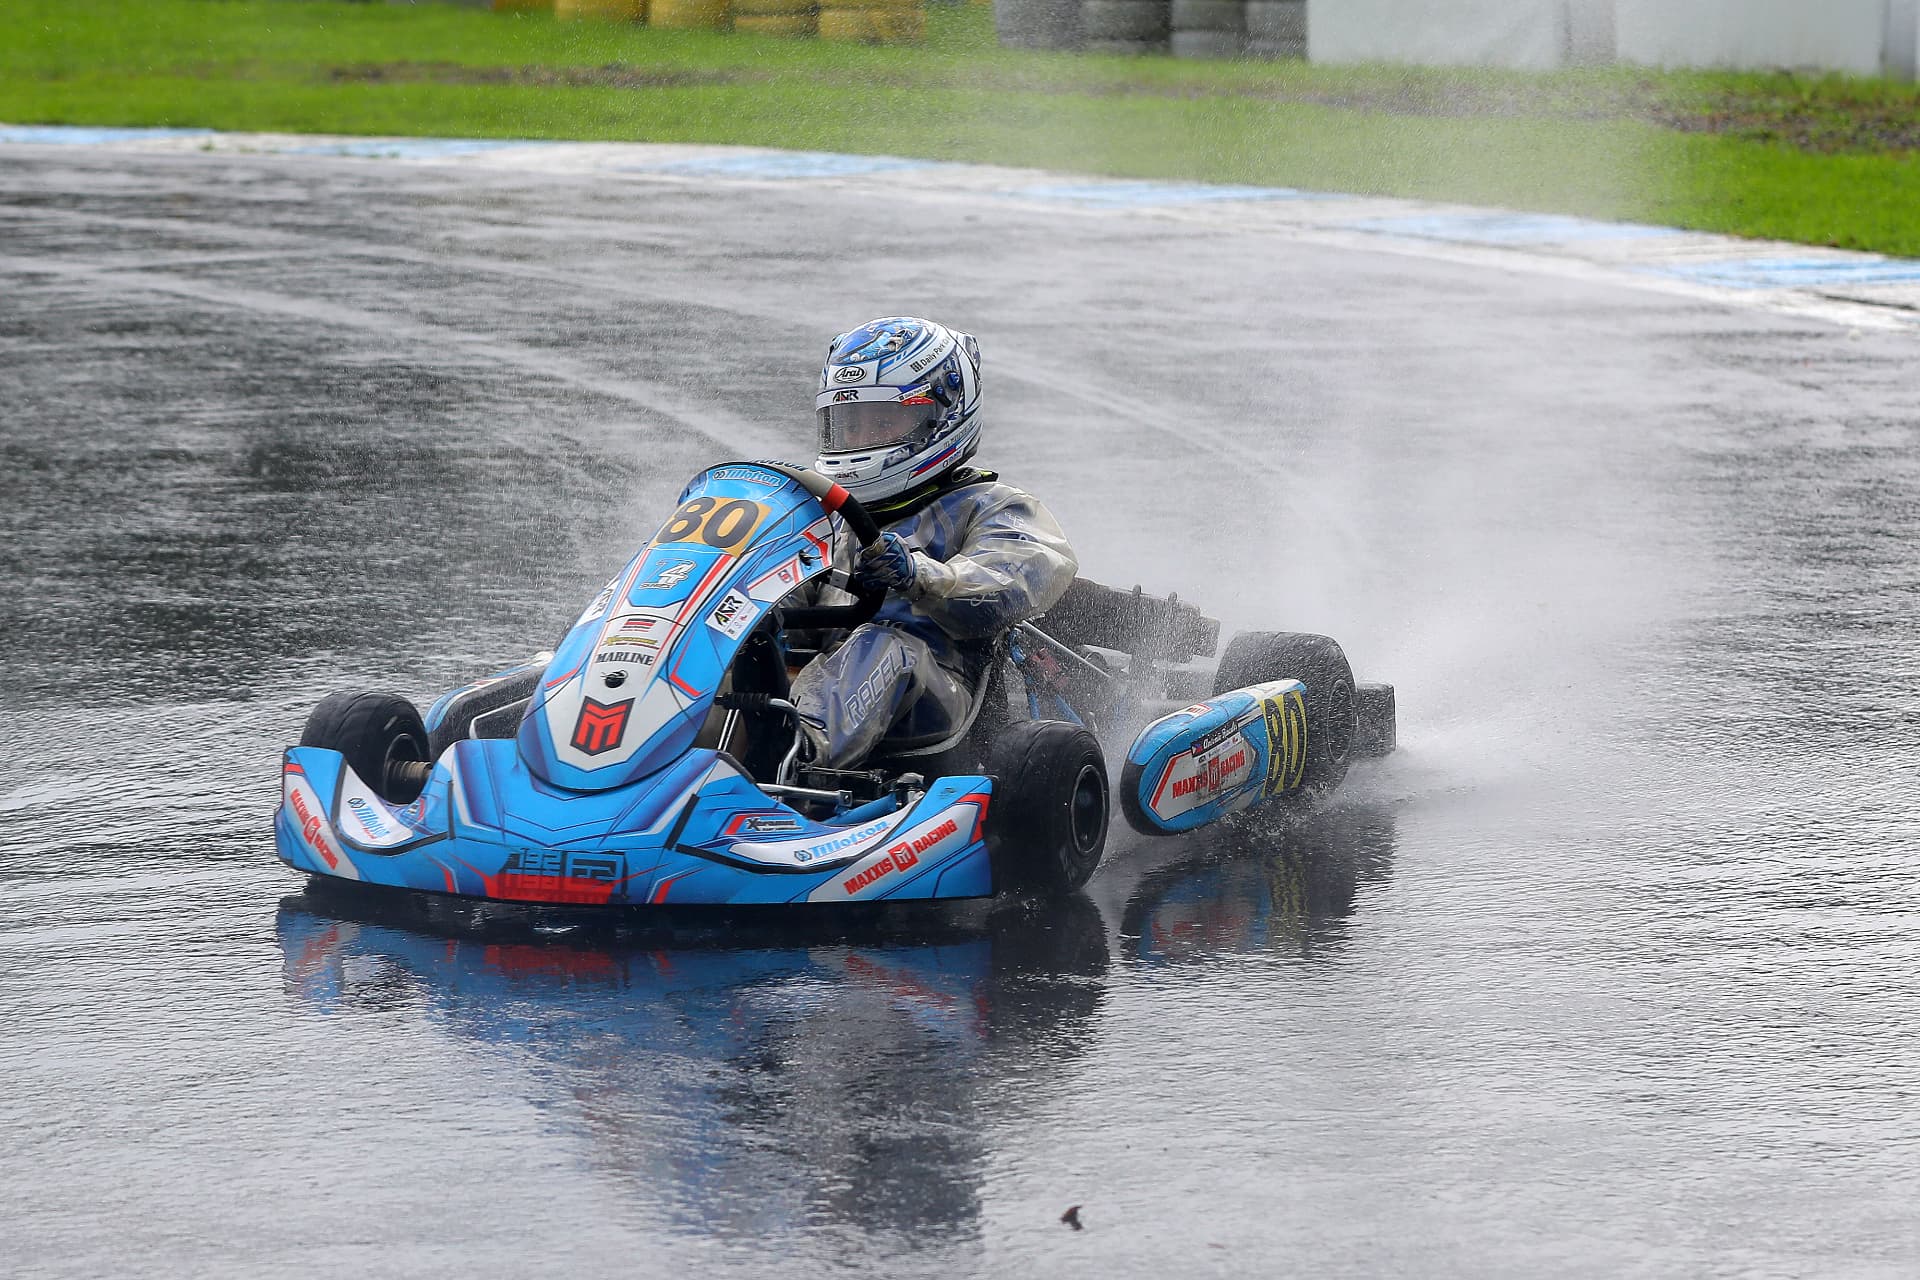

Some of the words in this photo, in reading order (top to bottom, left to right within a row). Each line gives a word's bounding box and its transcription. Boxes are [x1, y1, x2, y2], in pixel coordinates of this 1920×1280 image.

[656, 496, 759, 548] 80
[595, 651, 655, 666] MARLINE
[809, 821, 889, 858] Tillotson
[843, 857, 894, 895] MAXXIS
[912, 819, 958, 853] RACING
